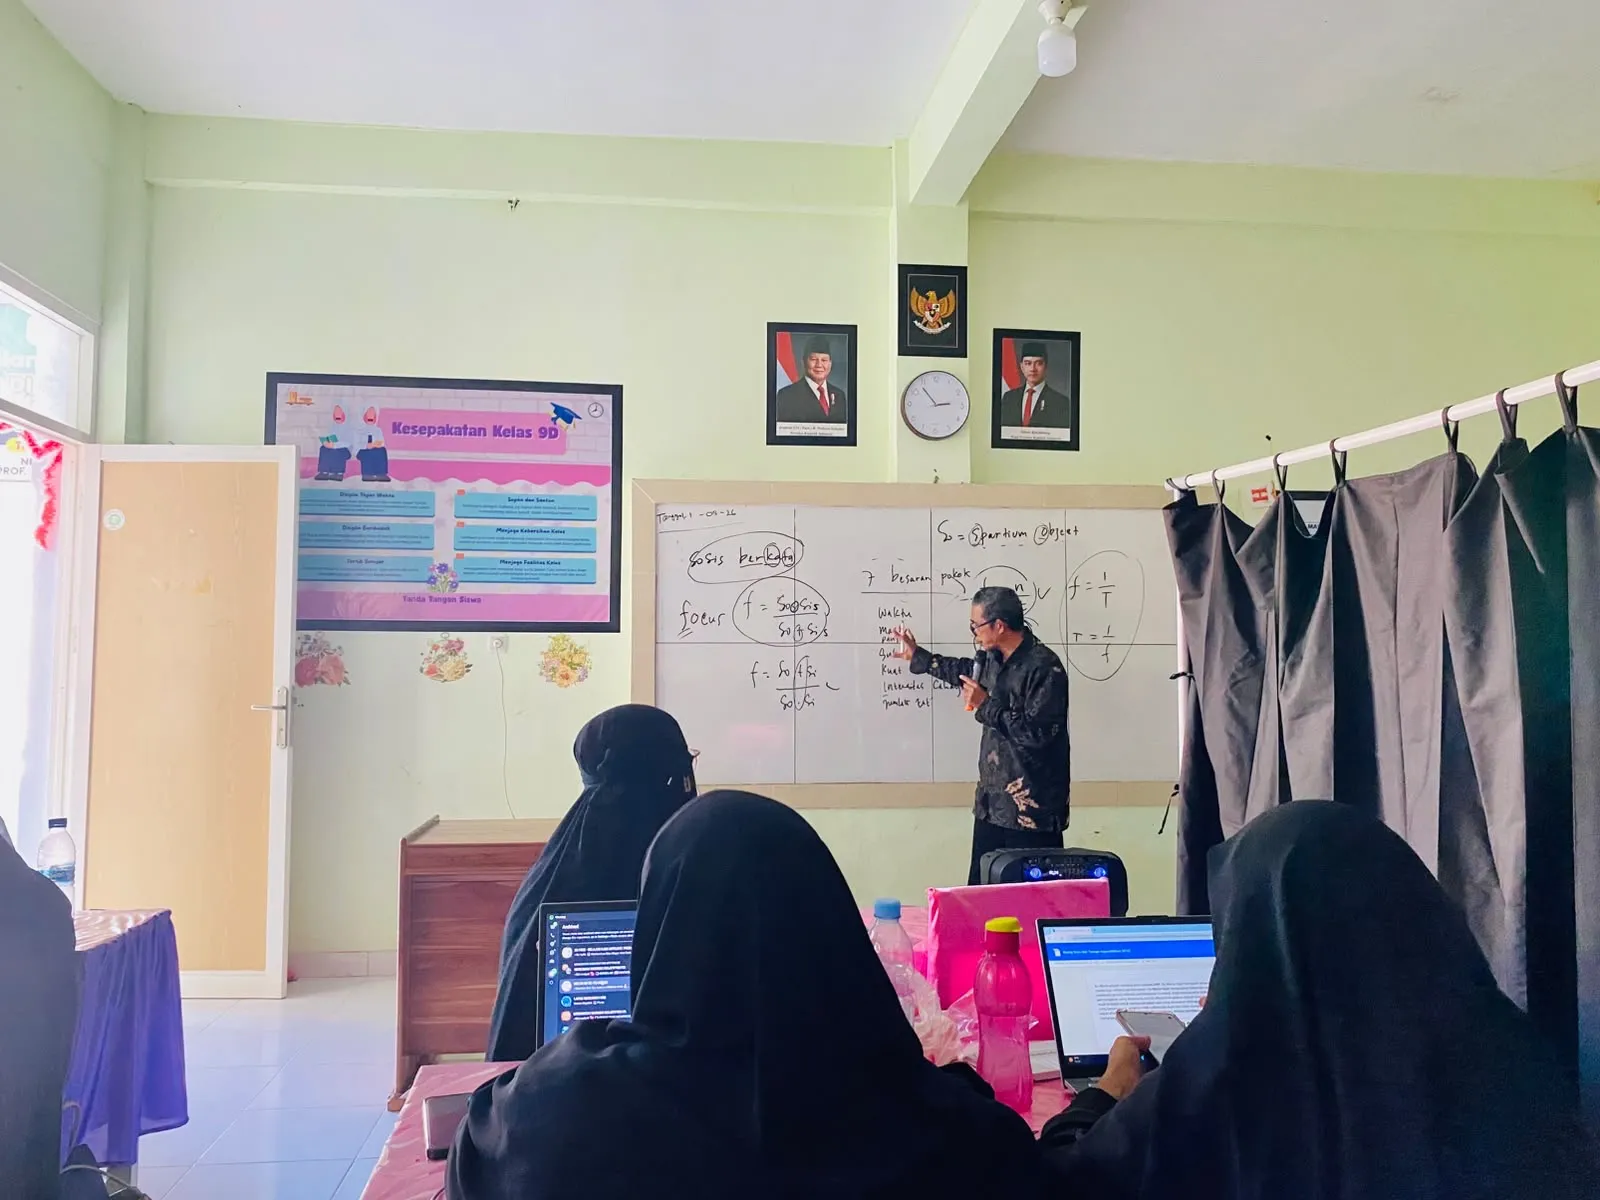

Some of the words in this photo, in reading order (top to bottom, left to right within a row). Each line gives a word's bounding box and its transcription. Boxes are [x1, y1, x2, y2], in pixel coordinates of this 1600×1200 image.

[392, 421, 487, 438] Kesepakatan
[492, 424, 533, 439] Kelas
[538, 426, 560, 440] 9D
[861, 570, 876, 588] 7
[891, 563, 932, 585] besaran
